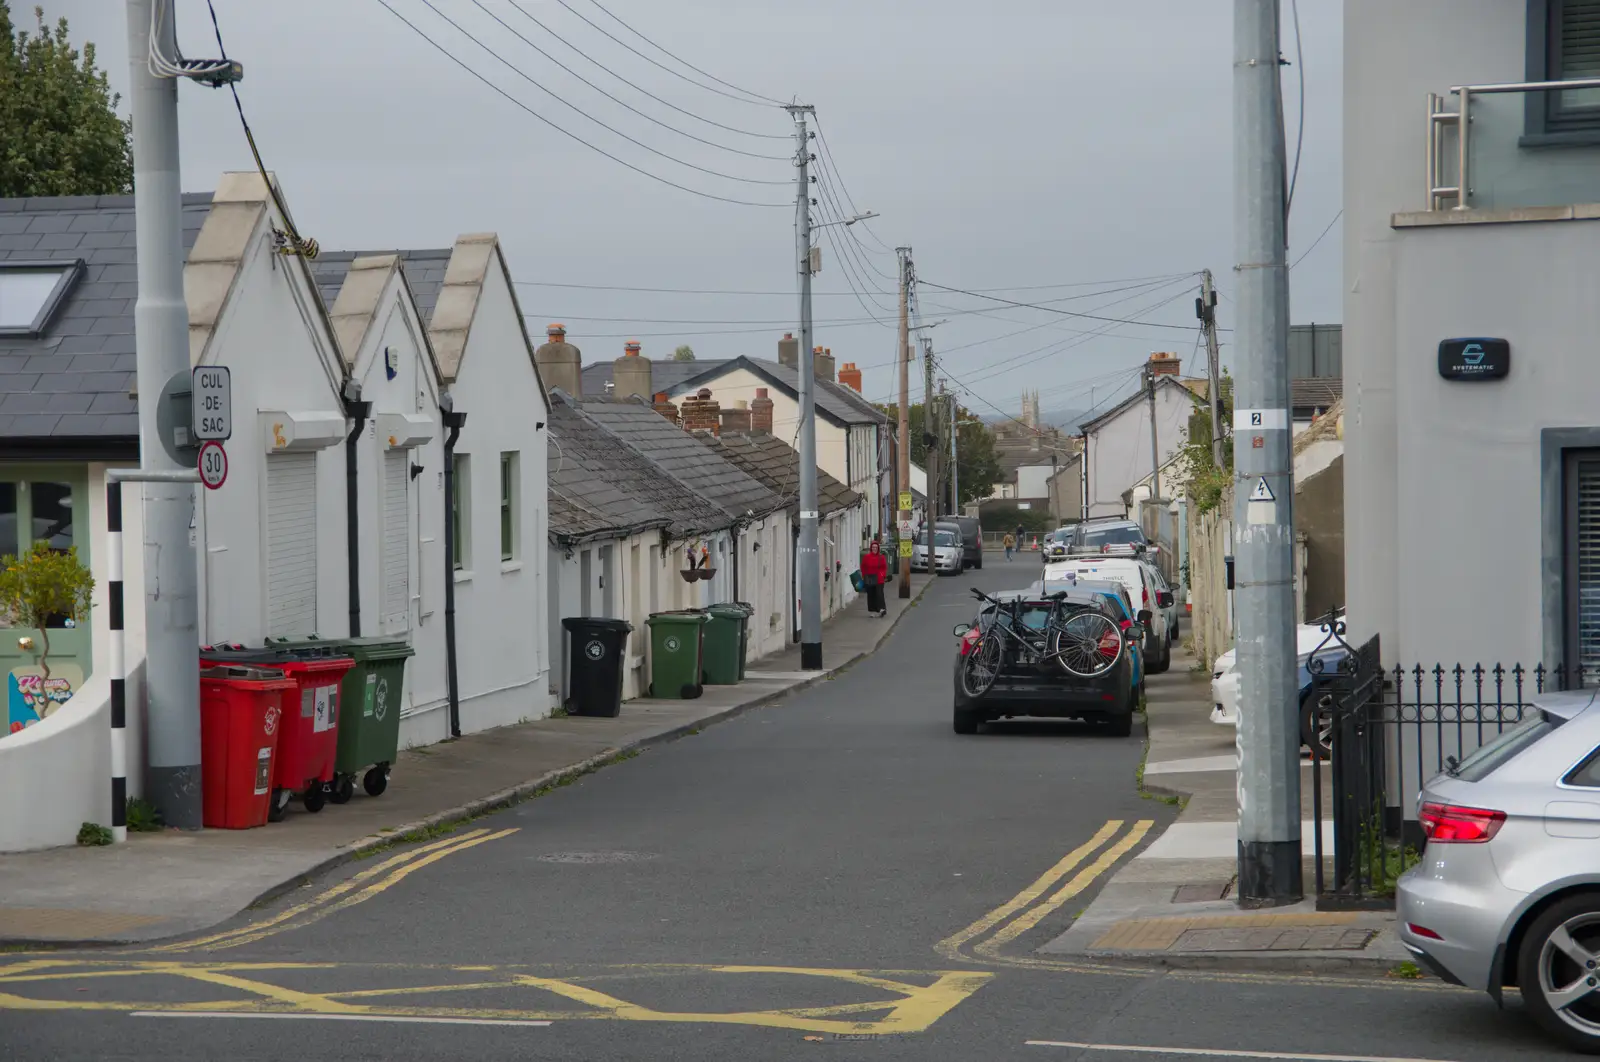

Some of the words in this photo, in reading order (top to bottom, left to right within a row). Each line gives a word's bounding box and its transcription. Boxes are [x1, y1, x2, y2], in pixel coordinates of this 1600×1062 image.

[201, 373, 223, 388] CUL
[202, 418, 224, 432] SAC
[1252, 413, 1261, 425] 2
[206, 452, 221, 472] 30
